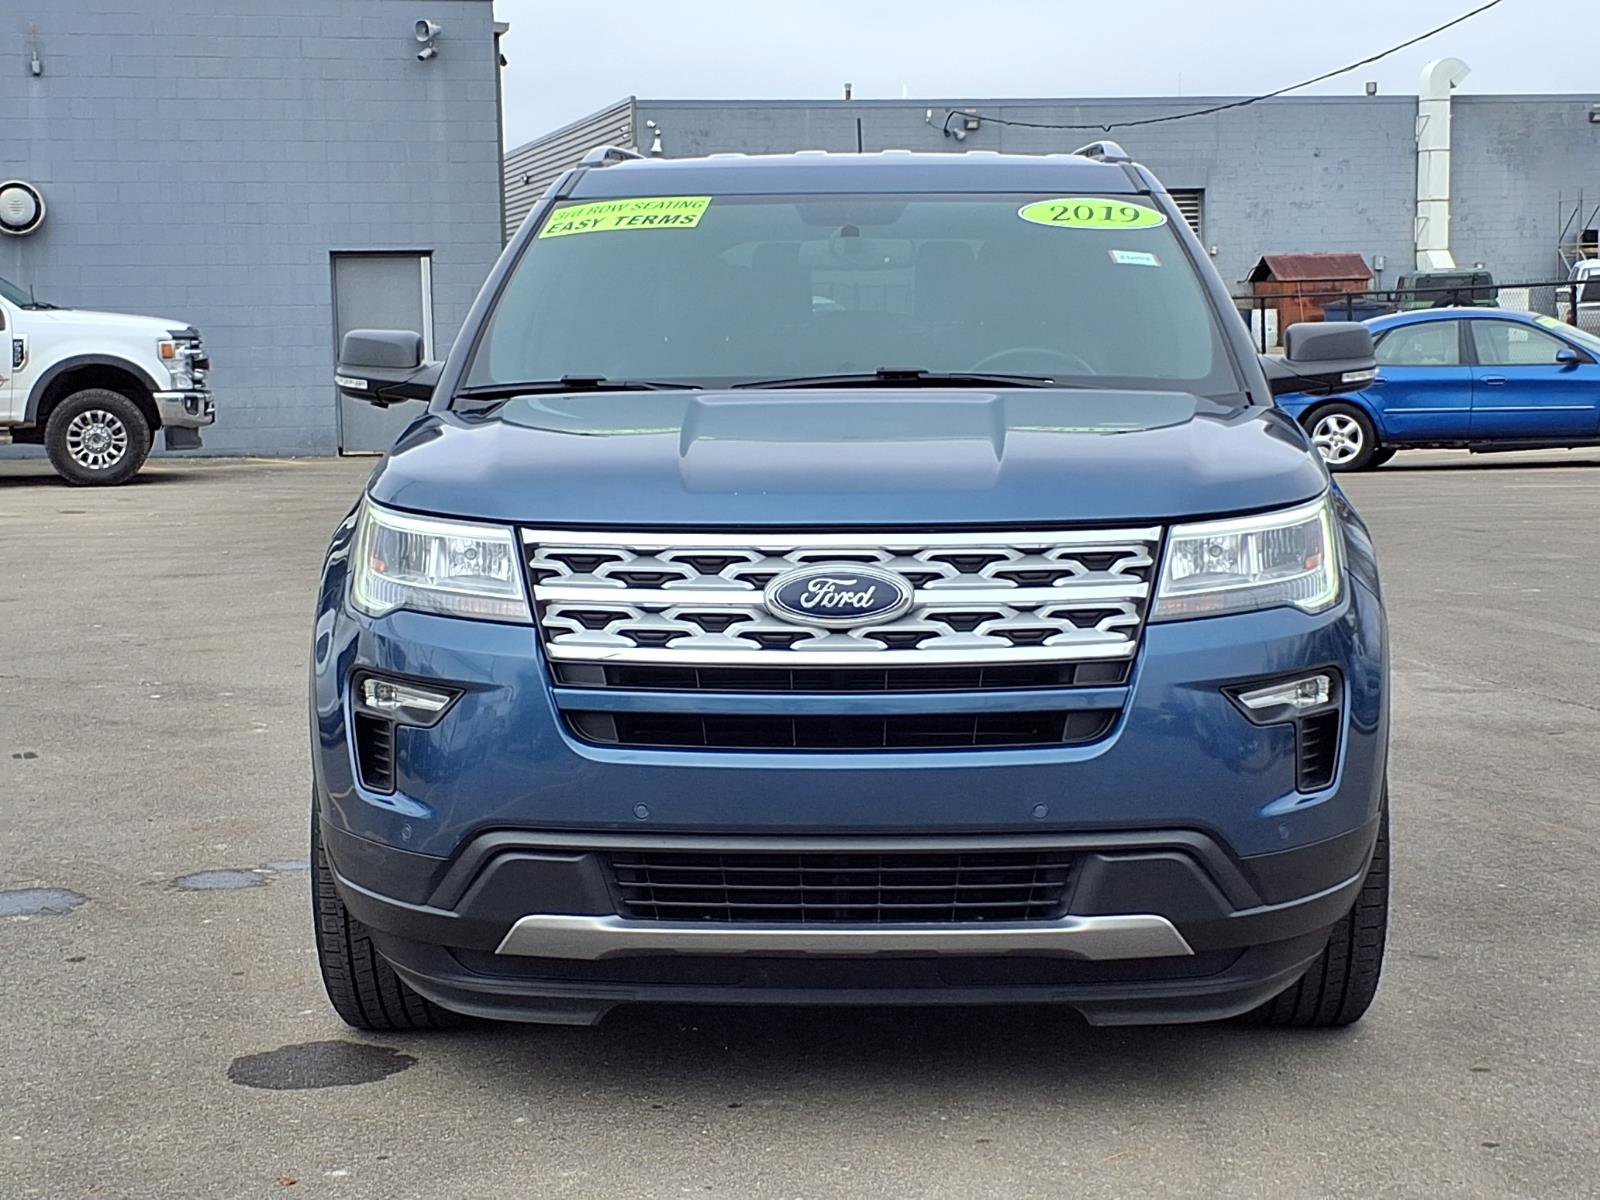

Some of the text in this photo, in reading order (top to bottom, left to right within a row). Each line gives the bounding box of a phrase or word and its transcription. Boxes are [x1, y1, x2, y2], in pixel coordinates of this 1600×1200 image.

[586, 203, 630, 216] ROW
[631, 199, 706, 212] SEATING
[1049, 205, 1141, 223] 2019
[546, 214, 698, 234] EASY TERMS
[800, 577, 876, 609] Ford
